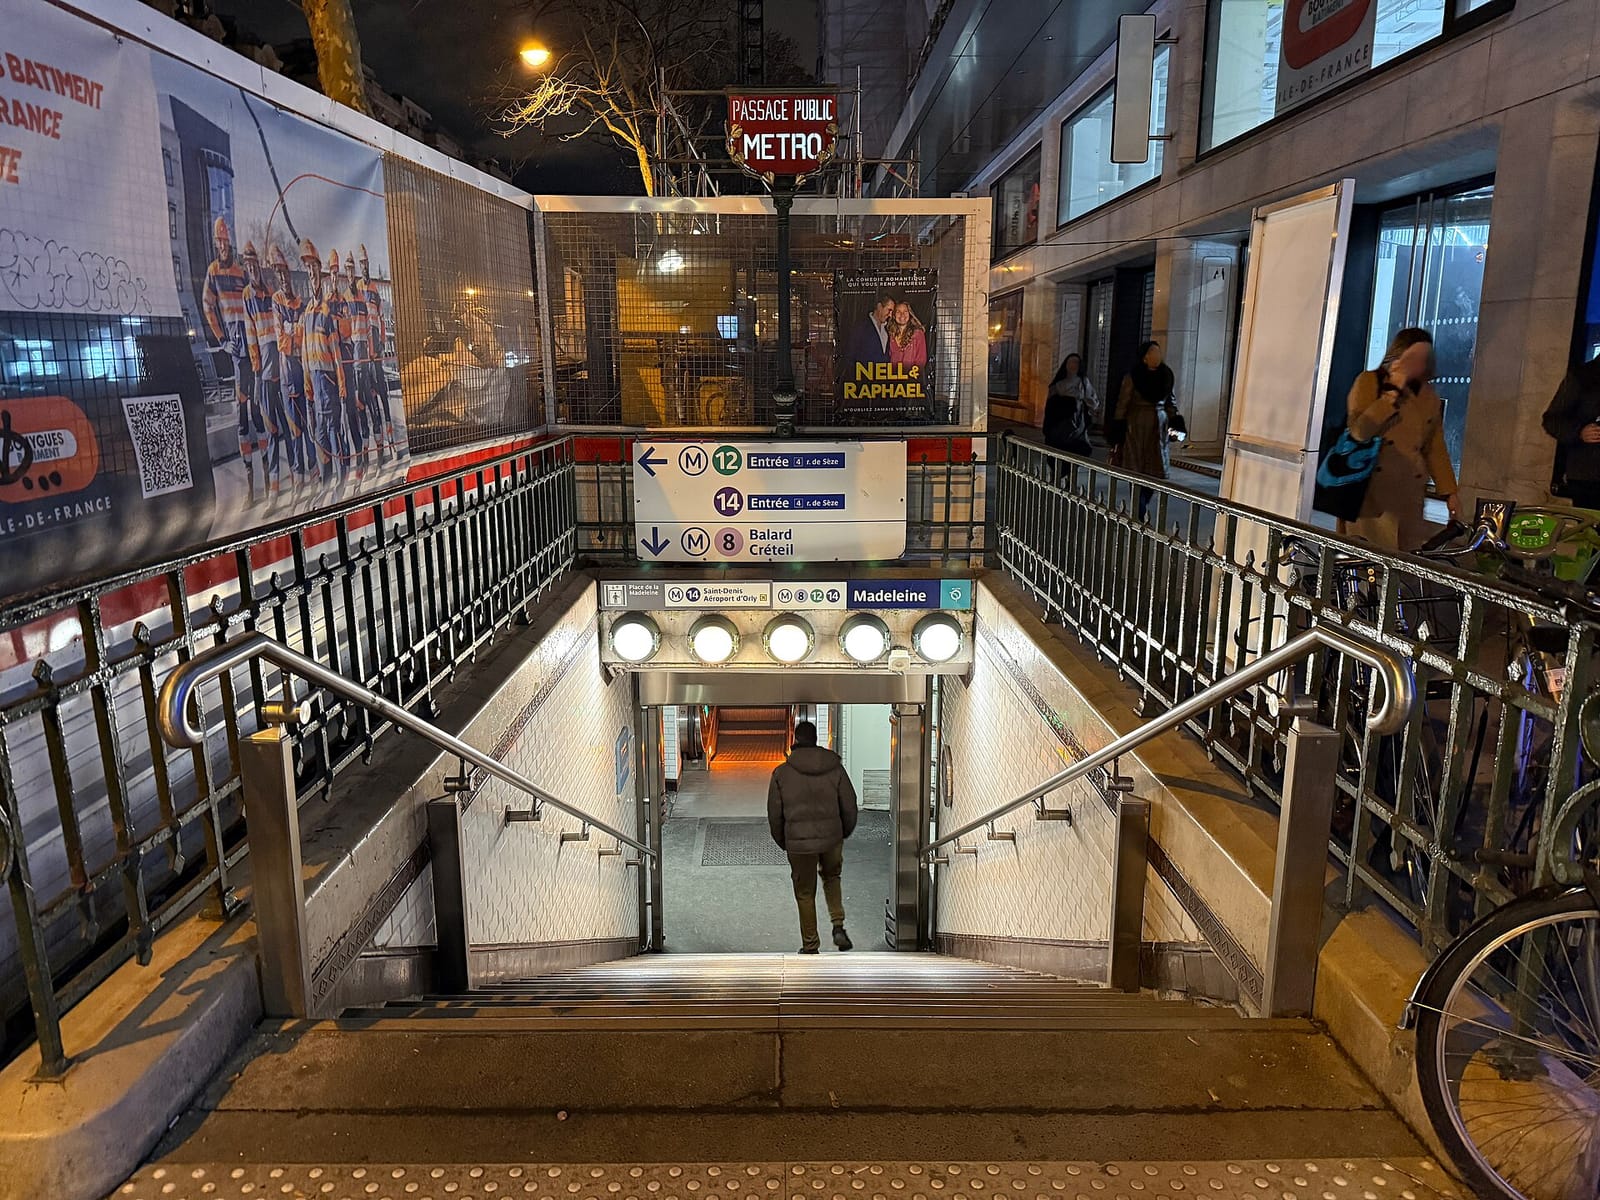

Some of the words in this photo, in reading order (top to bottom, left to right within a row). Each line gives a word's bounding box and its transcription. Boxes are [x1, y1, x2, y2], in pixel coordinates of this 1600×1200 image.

[5, 52, 104, 109] BATIMENT
[732, 99, 789, 121] PASSAGE
[794, 99, 834, 121] PUBLIC
[743, 133, 822, 160] METRO
[855, 361, 908, 380] NELL
[909, 365, 920, 379] &
[844, 382, 925, 399] RAPHAEL
[715, 451, 739, 470] 12
[750, 456, 789, 467] Entrée
[823, 457, 839, 465] Sèze
[717, 493, 740, 511] 14
[751, 497, 789, 508] Entrée
[723, 533, 735, 550] 8
[750, 529, 792, 540] Balard
[750, 544, 794, 555] Créteil
[687, 591, 699, 600] 14
[703, 594, 734, 602] Aéroport
[736, 594, 757, 603] d'Orly
[811, 592, 823, 600] 12
[827, 592, 839, 600] 14
[853, 590, 927, 602] Madeleine
